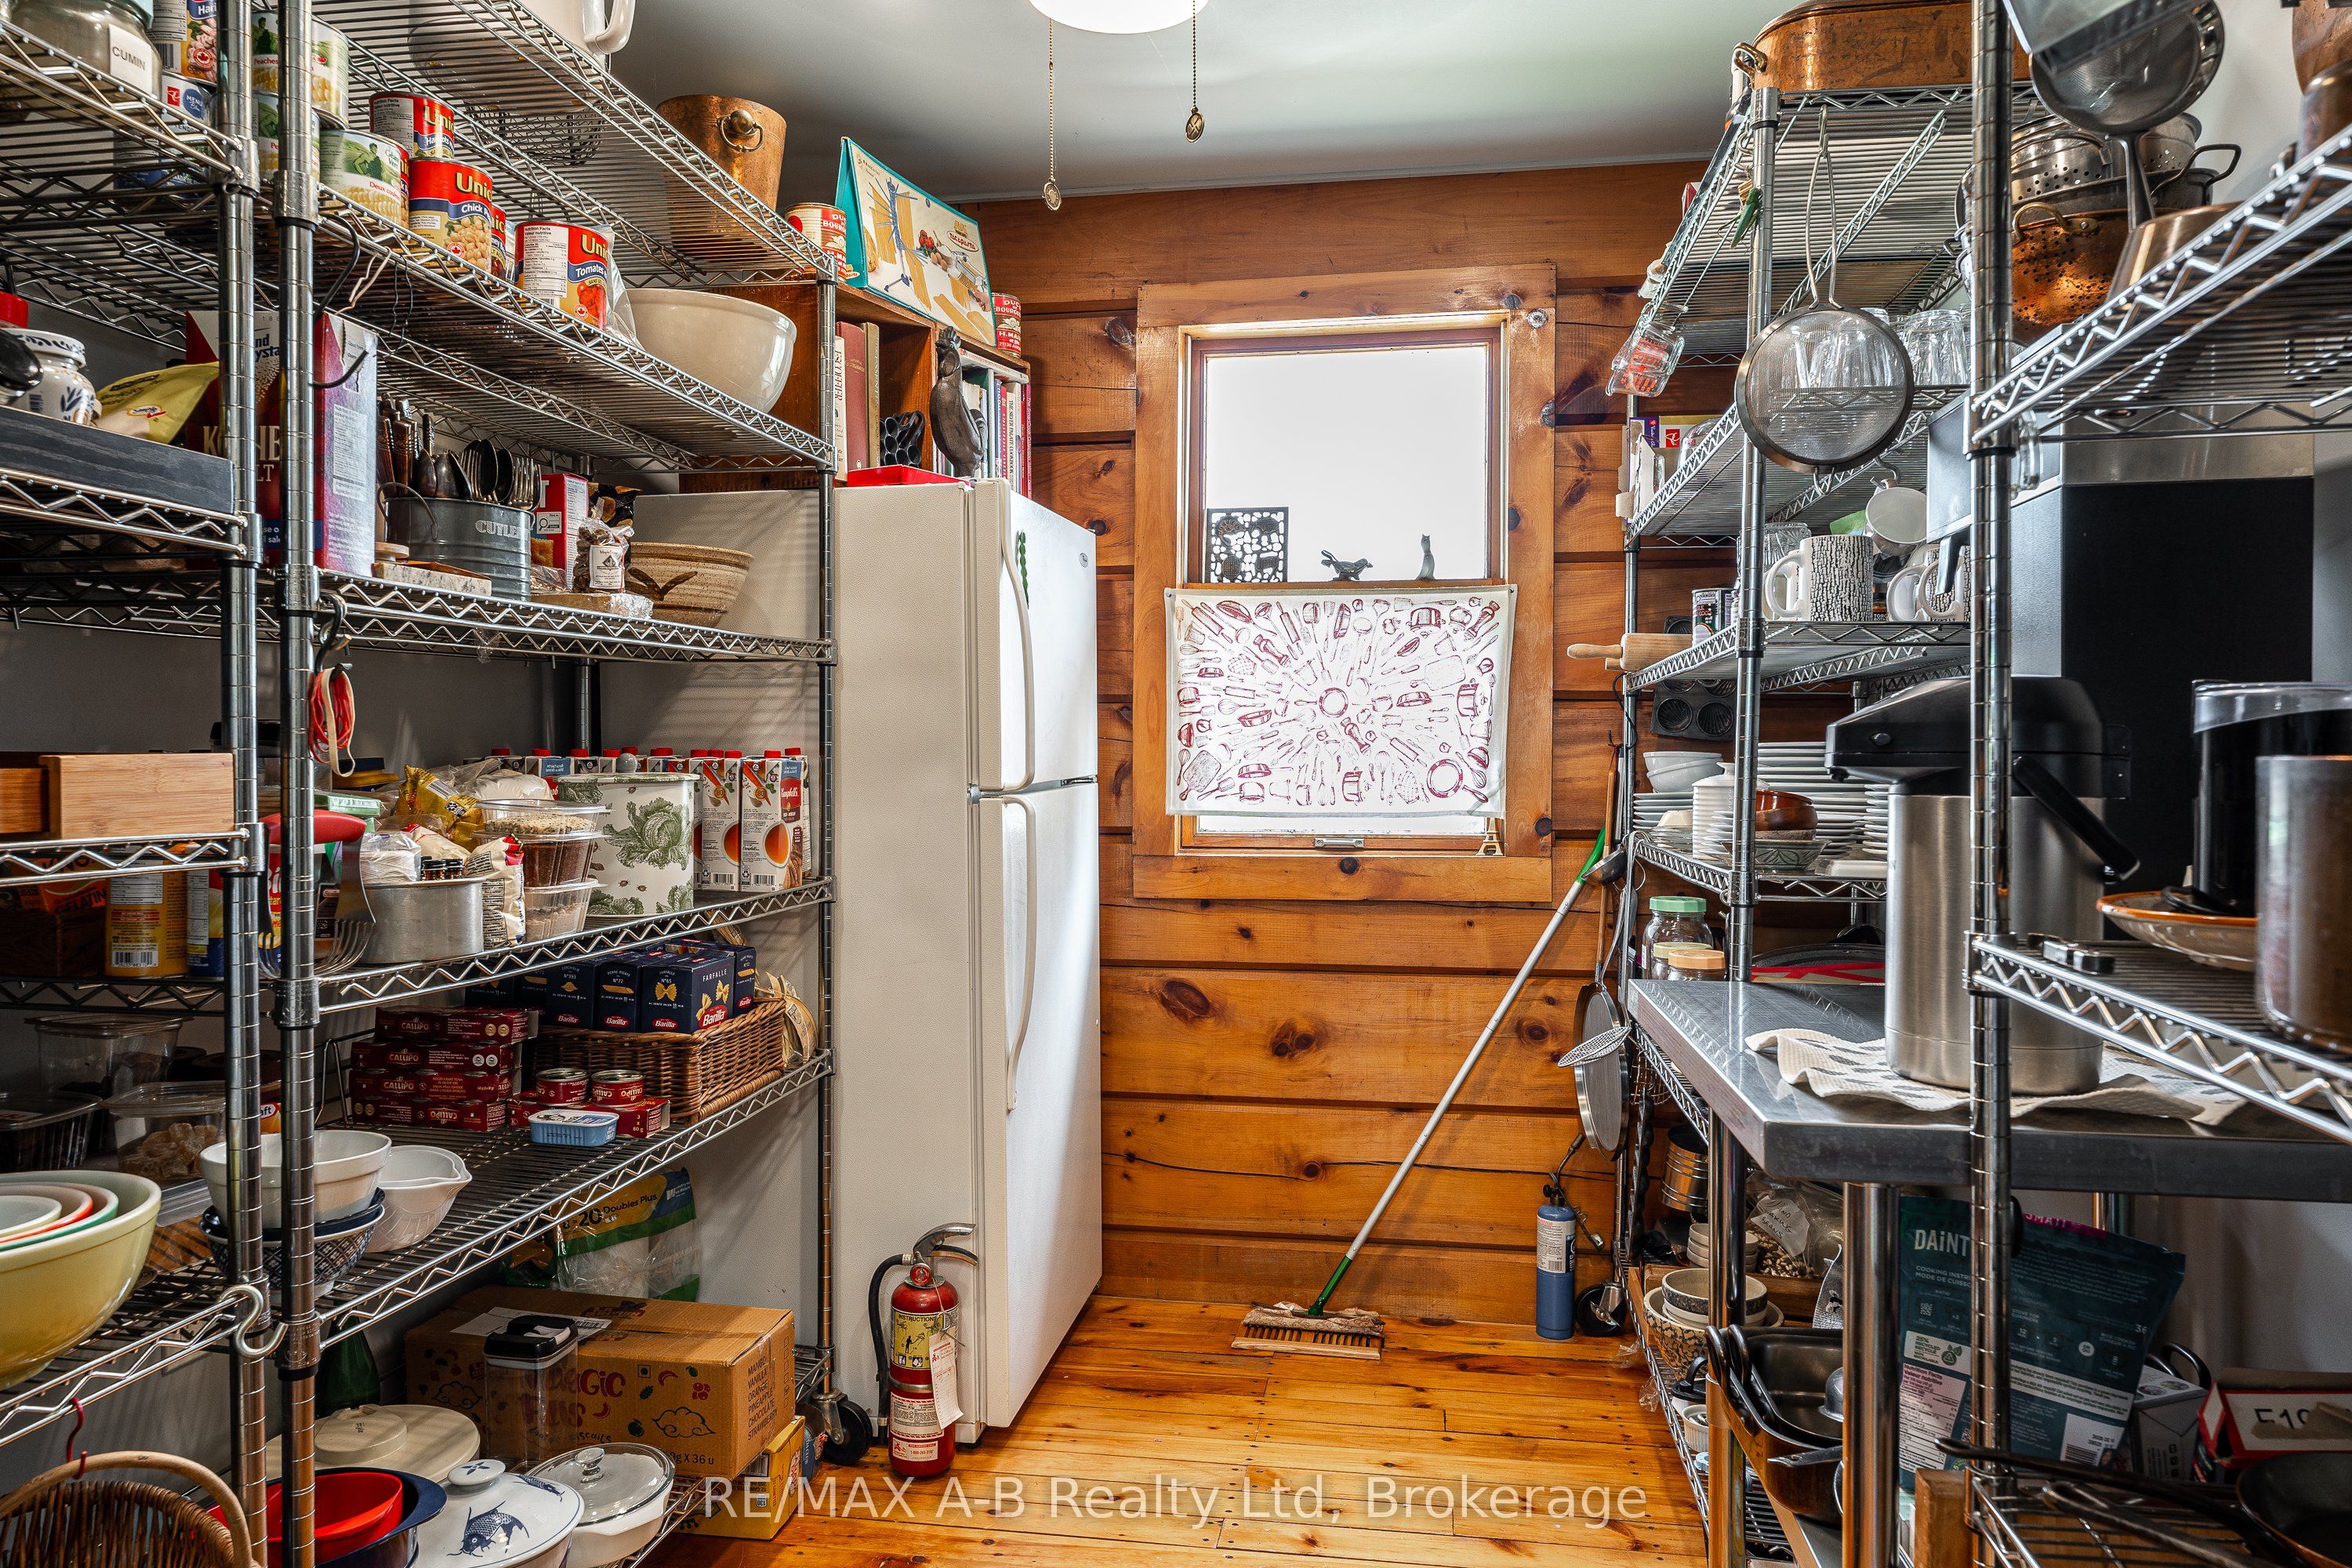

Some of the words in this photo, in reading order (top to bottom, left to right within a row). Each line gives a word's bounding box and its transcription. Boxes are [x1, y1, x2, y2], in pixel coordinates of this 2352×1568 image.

[112, 45, 146, 71] CUMIN
[186, 94, 203, 107] MENU
[369, 180, 386, 193] Deux
[461, 203, 483, 213] Chick
[575, 263, 604, 278] Tomates
[757, 788, 765, 797] 80
[781, 786, 799, 800] Campbell's
[702, 968, 728, 982] FARFALLE
[739, 998, 752, 1007] Barilla
[557, 1015, 579, 1024] Barilla
[605, 1017, 627, 1026] Barilla
[702, 1009, 726, 1027] Barilla
[401, 1021, 430, 1031] CALLIPO
[389, 1052, 420, 1062] CALLIPO
[383, 1080, 415, 1091] CALLIPO
[620, 1088, 644, 1098] CALLIPO
[430, 1110, 458, 1120] CALLIPO
[602, 1199, 639, 1214] Doubles
[640, 1193, 658, 1205] Plus
[579, 1207, 603, 1228] 20
[1761, 1216, 1784, 1240] BEANS
[1915, 1265, 1948, 1276] COOKING
[1915, 1272, 1936, 1281] MODE
[1915, 1340, 1941, 1351] RECYCLED
[1913, 1354, 1940, 1364] RECYCLABLE
[747, 1356, 766, 1376] MANGO
[1904, 1363, 1928, 1375] Nutrition
[1928, 1370, 1943, 1380] Facts
[747, 1368, 768, 1389] VANILLA
[1904, 1369, 1921, 1380] Valeur
[1921, 1374, 1943, 1386] nutritive
[747, 1380, 768, 1403] ORANGE
[747, 1387, 774, 1414] PINEAPPLE
[747, 1400, 775, 1428] CHOCOLATE
[747, 1407, 779, 1441] STRAWBERRY
[691, 1453, 706, 1465] 36
